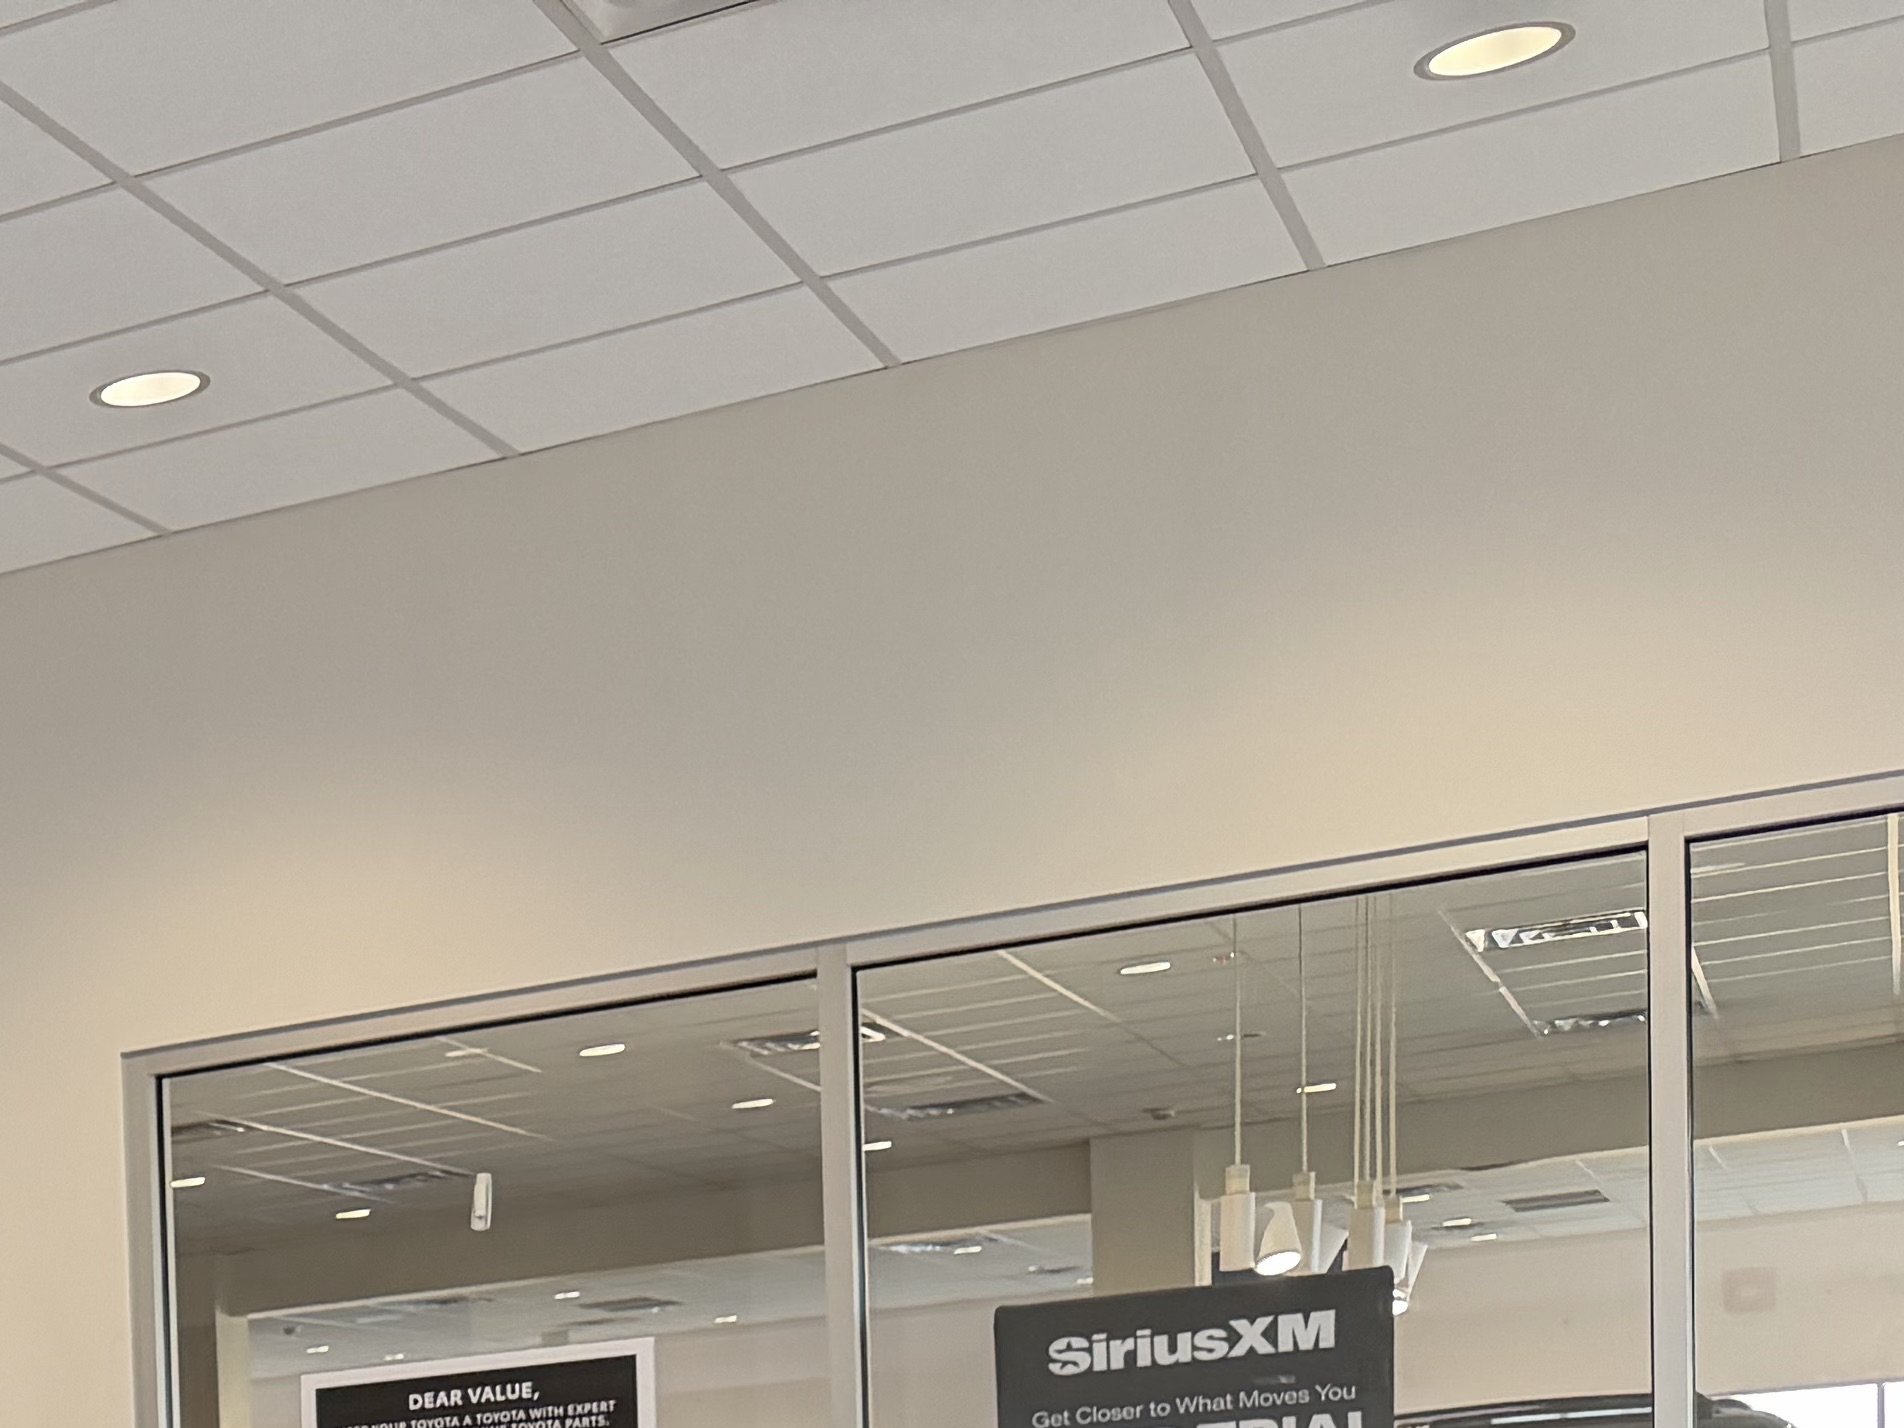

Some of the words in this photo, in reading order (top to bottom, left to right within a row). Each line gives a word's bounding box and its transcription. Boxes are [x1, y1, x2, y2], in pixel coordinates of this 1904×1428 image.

[1048, 1309, 1336, 1376] SiriusXM
[409, 1389, 462, 1410] DEAR
[467, 1381, 540, 1404] VALUE,
[1032, 1409, 1070, 1428] Get
[1076, 1402, 1143, 1425] Closer
[1149, 1401, 1170, 1417] to
[1176, 1393, 1232, 1415] What
[1239, 1387, 1309, 1408] Moves
[1315, 1382, 1356, 1403] You
[463, 1415, 472, 1425] A
[476, 1409, 526, 1424] TOYOTA
[529, 1405, 564, 1419] WITH
[567, 1400, 616, 1416] EXPERT
[565, 1415, 610, 1428] PARTS.
